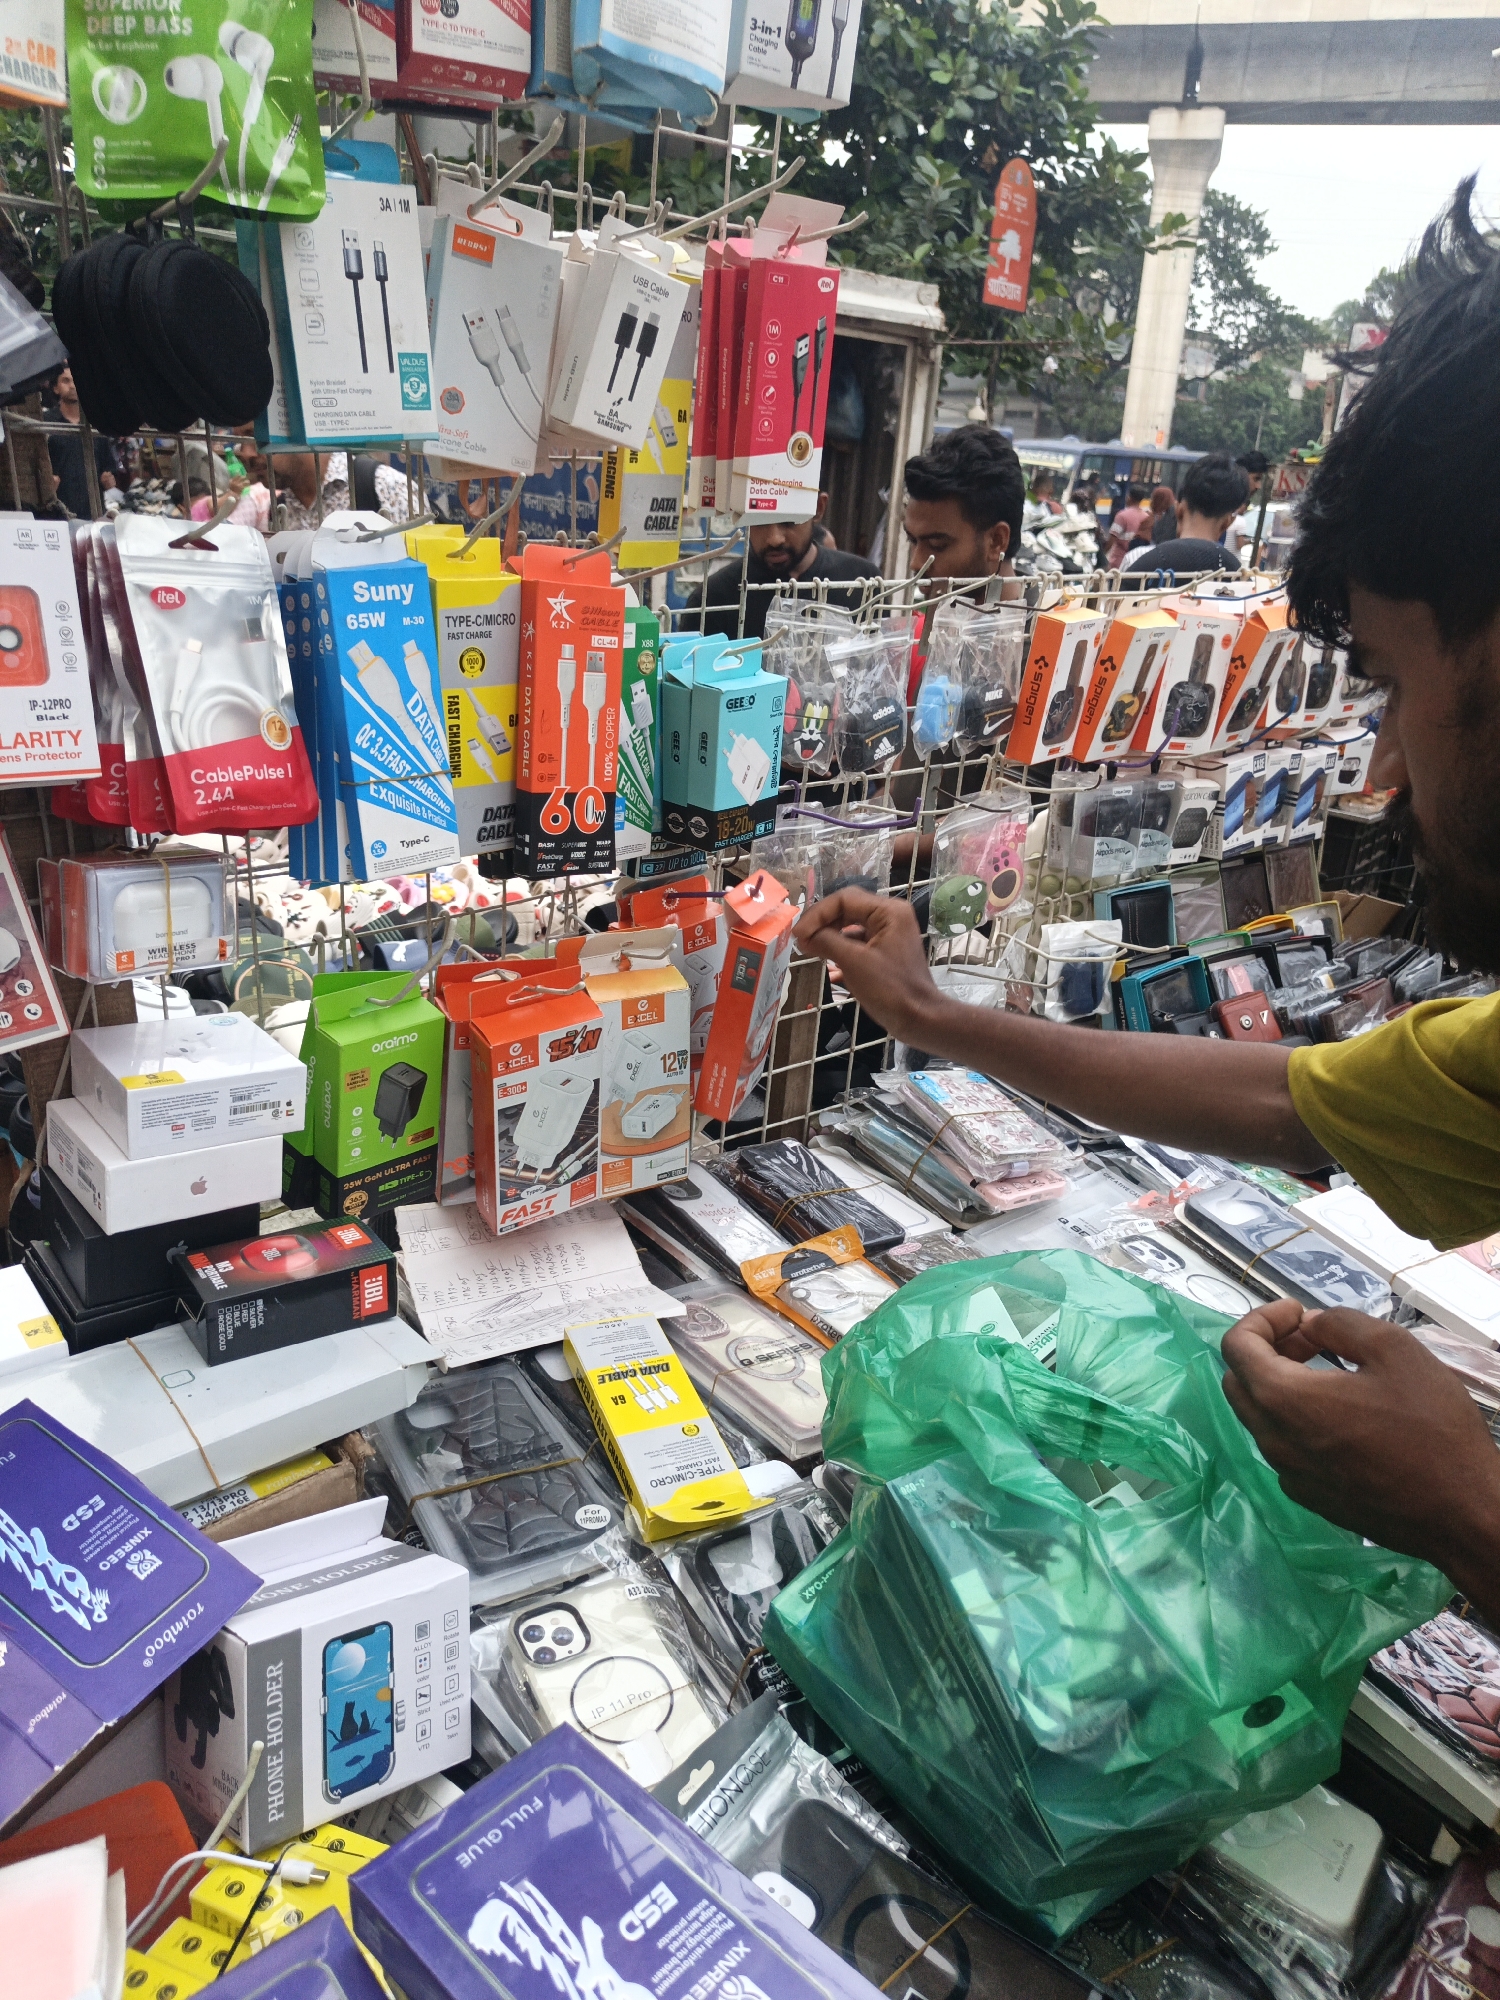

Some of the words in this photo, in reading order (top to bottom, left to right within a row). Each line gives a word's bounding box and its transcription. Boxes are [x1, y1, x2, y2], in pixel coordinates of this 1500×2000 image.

[86, 15, 137, 36] DEEP
[144, 16, 193, 37] BASS
[422, 18, 448, 29] TYPE-C
[449, 23, 459, 32] TO
[460, 26, 486, 38] TYPE-C
[750, 17, 781, 37] 3-in-1
[748, 43, 767, 56] Cable
[749, 33, 779, 50] Charging
[27, 39, 57, 70] CAR
[379, 197, 392, 212] 3A
[399, 199, 411, 214] 1M
[633, 274, 649, 289] USB
[650, 283, 670, 299] Cable
[772, 275, 784, 284] C11
[768, 324, 780, 335] 1M
[313, 411, 341, 419] CHARGING
[341, 410, 358, 418] DATA
[359, 410, 376, 418] CABLE
[609, 409, 618, 419] 8A
[678, 410, 687, 424] 6A
[597, 417, 624, 433] SAMSUNG
[750, 487, 767, 497] Data
[767, 488, 789, 497] Cable
[751, 478, 771, 488] Super
[772, 479, 803, 490] Charging
[650, 497, 677, 512] DATA
[757, 501, 774, 509] Type-C
[644, 515, 680, 531] CABLE
[157, 590, 180, 605] itel
[352, 580, 414, 604] Suny
[347, 611, 386, 629] 65W
[402, 616, 424, 626] M-30
[445, 612, 515, 628] TYPE-C/MICRO
[552, 621, 569, 630] KZI
[447, 632, 463, 640] FAST
[465, 631, 492, 640] CHARGE
[597, 638, 617, 646] CL-44
[642, 639, 654, 648] X88
[466, 658, 479, 666] 1000
[985, 689, 1003, 702] NIKE
[1023, 673, 1044, 726] spigen
[1082, 675, 1108, 726] spigen
[28, 698, 72, 713] IP-12PRO
[447, 695, 460, 721] FAST
[523, 687, 531, 728] DATA
[873, 703, 896, 721] adidas
[36, 713, 70, 722] Black
[272, 719, 283, 732] 12
[406, 691, 434, 744] DATA
[605, 707, 616, 750] COPPER
[0, 730, 83, 751] LARITY
[0, 752, 21, 764] ens
[25, 751, 83, 762] Protector
[448, 723, 462, 779] CHARGING
[521, 732, 530, 778] CABLE
[355, 723, 376, 749] QC
[407, 773, 451, 813] CHARGING
[605, 751, 614, 782] 100%
[1254, 757, 1265, 772] CASE
[191, 764, 285, 785] CablePulse
[194, 787, 235, 805] 2.4A
[369, 776, 421, 817] Exquisite
[619, 773, 637, 803] FAST
[483, 806, 515, 822] DATA
[400, 836, 429, 849] Type-C
[715, 838, 729, 848] FAST
[730, 832, 753, 844] CHARGER
[688, 938, 711, 950] EXCEL
[627, 1011, 659, 1026] EXCEL
[372, 1032, 419, 1054] oraimo
[498, 1055, 535, 1072] EXCEL
[630, 1060, 642, 1082] EXCEL
[498, 1083, 527, 1098] E-300+
[324, 1080, 332, 1129] oraimo
[538, 1105, 549, 1129] EXCEL
[384, 1162, 411, 1176] ULTRA
[413, 1154, 432, 1166] FAST
[501, 1193, 558, 1225] FAST
[337, 1228, 362, 1245] JBL
[202, 1261, 228, 1291] PORTABLE
[216, 1260, 234, 1274] M3
[351, 1275, 362, 1321] HARMAN
[364, 1276, 384, 1309] JBL
[218, 1314, 226, 1333] ROSE
[226, 1313, 234, 1340] GOLDEN
[219, 1333, 227, 1351] GOLD
[755, 1342, 813, 1362] SERIES
[597, 1368, 640, 1385] CABLE
[640, 1363, 670, 1378] DATA
[611, 1394, 627, 1406] 6A
[676, 1460, 702, 1472] CHARGE
[704, 1457, 721, 1467] FAST
[650, 1465, 726, 1489] TYPE-C/MICRO
[192, 1488, 247, 1514] 13/13PRO
[229, 1495, 250, 1508] 16E
[61, 1494, 106, 1532] ESD
[579, 1516, 608, 1526] 11PROMAX
[583, 1508, 601, 1516] For
[97, 1525, 152, 1573] XINREEO
[250, 1583, 305, 1605] HONE
[311, 1553, 400, 1586] HOLDER
[628, 1584, 643, 1596] A33
[444, 1632, 459, 1641] Rotate
[414, 1642, 432, 1652] ALLOY
[266, 1660, 284, 1747] HOLDER
[417, 1707, 431, 1716] Strict
[591, 1706, 607, 1720] IP
[609, 1700, 624, 1714] 11
[629, 1689, 652, 1710] Pro
[268, 1750, 285, 1823] PHONE
[508, 1795, 544, 1831] FULL
[456, 1829, 503, 1869] GLUE
[619, 1881, 678, 1941] ESD
[684, 1910, 727, 1951] technology
[703, 1917, 735, 1950] Physical
[651, 1956, 679, 1983] broken
